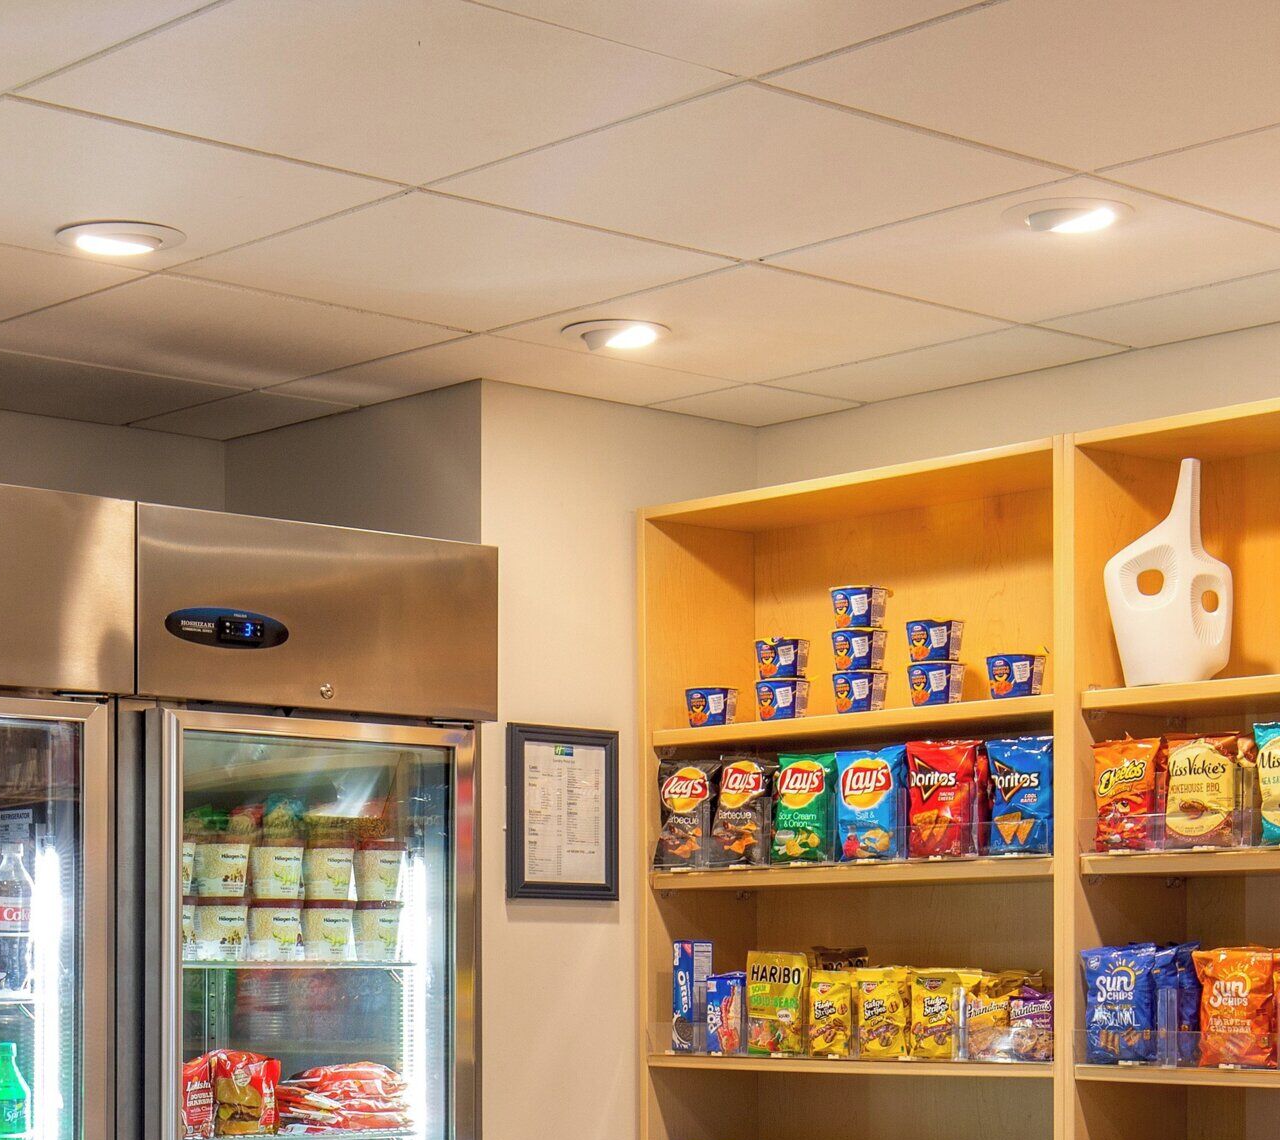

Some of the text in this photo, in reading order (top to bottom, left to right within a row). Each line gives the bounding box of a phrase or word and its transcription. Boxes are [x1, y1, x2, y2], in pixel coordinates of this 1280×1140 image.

[1187, 753, 1226, 780] Vickie's
[723, 768, 759, 795] Lay's
[780, 768, 822, 795] Lay's
[844, 766, 888, 796] Lay's
[910, 771, 957, 787] Doritos
[664, 777, 705, 799] Lay's
[1206, 783, 1222, 793] BBQ
[792, 811, 817, 820] Cream
[789, 819, 808, 828] Onion
[3, 907, 31, 921] Coke
[751, 964, 801, 986] HARIBO
[677, 970, 688, 1014] OREO
[1096, 974, 1136, 1003] Sun
[1107, 991, 1134, 1001] CHIPS
[1209, 978, 1251, 1008] Sun
[864, 999, 885, 1010] Fudge
[923, 996, 947, 1009] Fudge
[1222, 997, 1249, 1007] CHIPS
[864, 1006, 887, 1020] Stripes
[924, 1003, 949, 1017] Stripes
